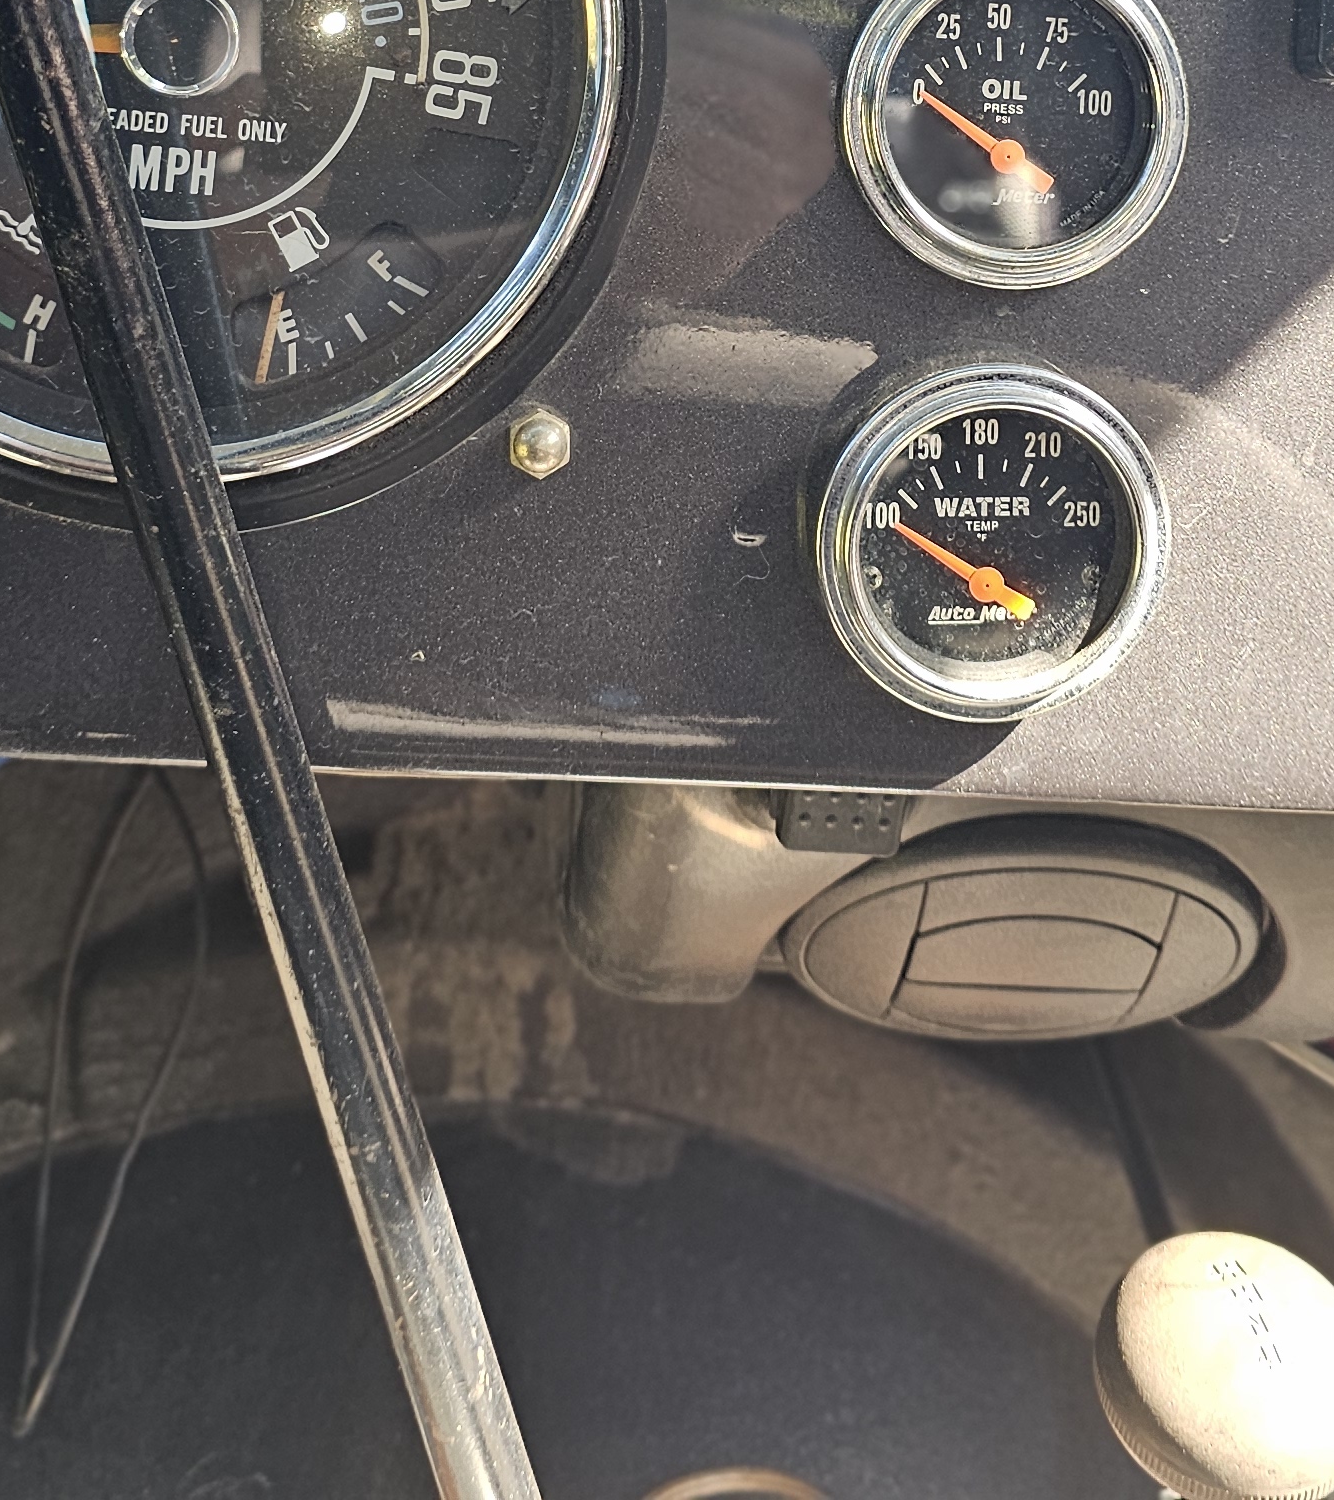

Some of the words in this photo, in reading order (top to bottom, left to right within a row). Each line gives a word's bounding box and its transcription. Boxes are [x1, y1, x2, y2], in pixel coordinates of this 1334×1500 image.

[936, 13, 961, 41] 25
[987, 3, 1012, 30] 50
[1045, 17, 1069, 44] 75
[1077, 88, 1112, 117] 100
[425, 49, 499, 126] 85
[912, 78, 926, 105] 0
[981, 78, 1028, 101] OIL
[983, 101, 1025, 116] PRESS
[995, 114, 1012, 125] PSI
[180, 113, 228, 139] FUEL
[237, 117, 288, 144] ONLY
[128, 143, 217, 196] MPH
[367, 249, 393, 283] F
[22, 293, 57, 321] H
[278, 308, 300, 343] E
[907, 433, 943, 461] 150
[962, 418, 999, 445] 180
[1024, 432, 1062, 458] 210
[1064, 501, 1101, 527] 250
[865, 501, 901, 529] 100
[934, 496, 1031, 518] WATER
[965, 520, 1000, 532] TEMP
[928, 605, 976, 624] Auto
